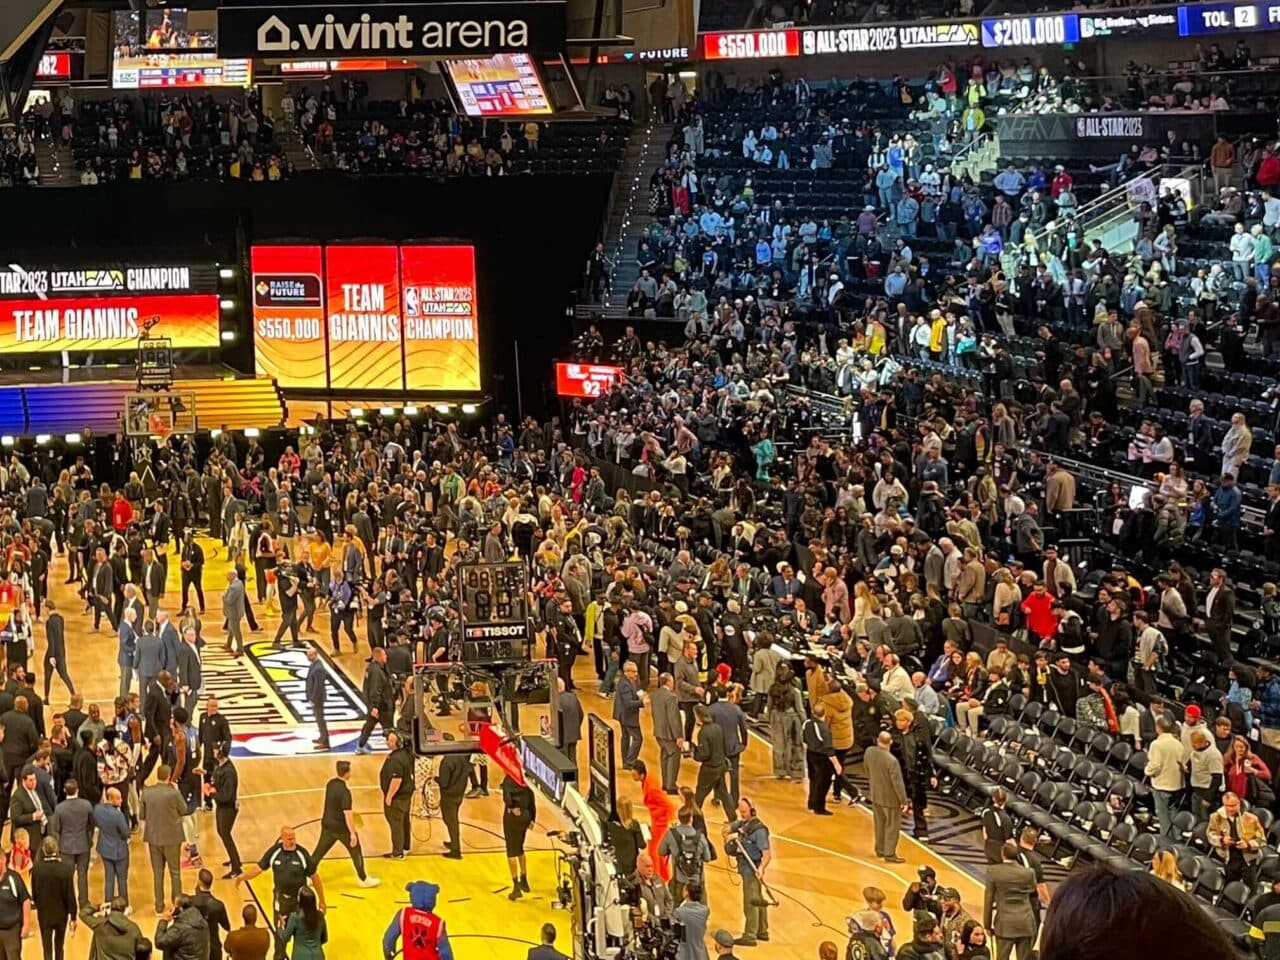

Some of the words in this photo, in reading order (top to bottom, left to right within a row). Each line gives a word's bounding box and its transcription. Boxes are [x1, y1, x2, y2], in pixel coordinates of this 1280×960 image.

[1203, 11, 1230, 27] TOL
[1241, 10, 1248, 23] 2
[298, 13, 413, 51] vivint
[422, 20, 528, 48] arena
[870, 27, 897, 50] 2023
[900, 27, 937, 45] UTAH
[21, 271, 48, 292] 2023
[51, 271, 86, 288] UTAH
[127, 268, 189, 290] CHAMPION
[342, 284, 384, 311] TEAM
[13, 310, 59, 341] TEAM
[64, 307, 139, 339] GIANNIS
[258, 318, 320, 339] $550,000
[331, 315, 400, 341] GIANNIS
[406, 318, 473, 339] CHAMPION
[583, 381, 600, 395] 92
[483, 626, 525, 637] TISSOT
